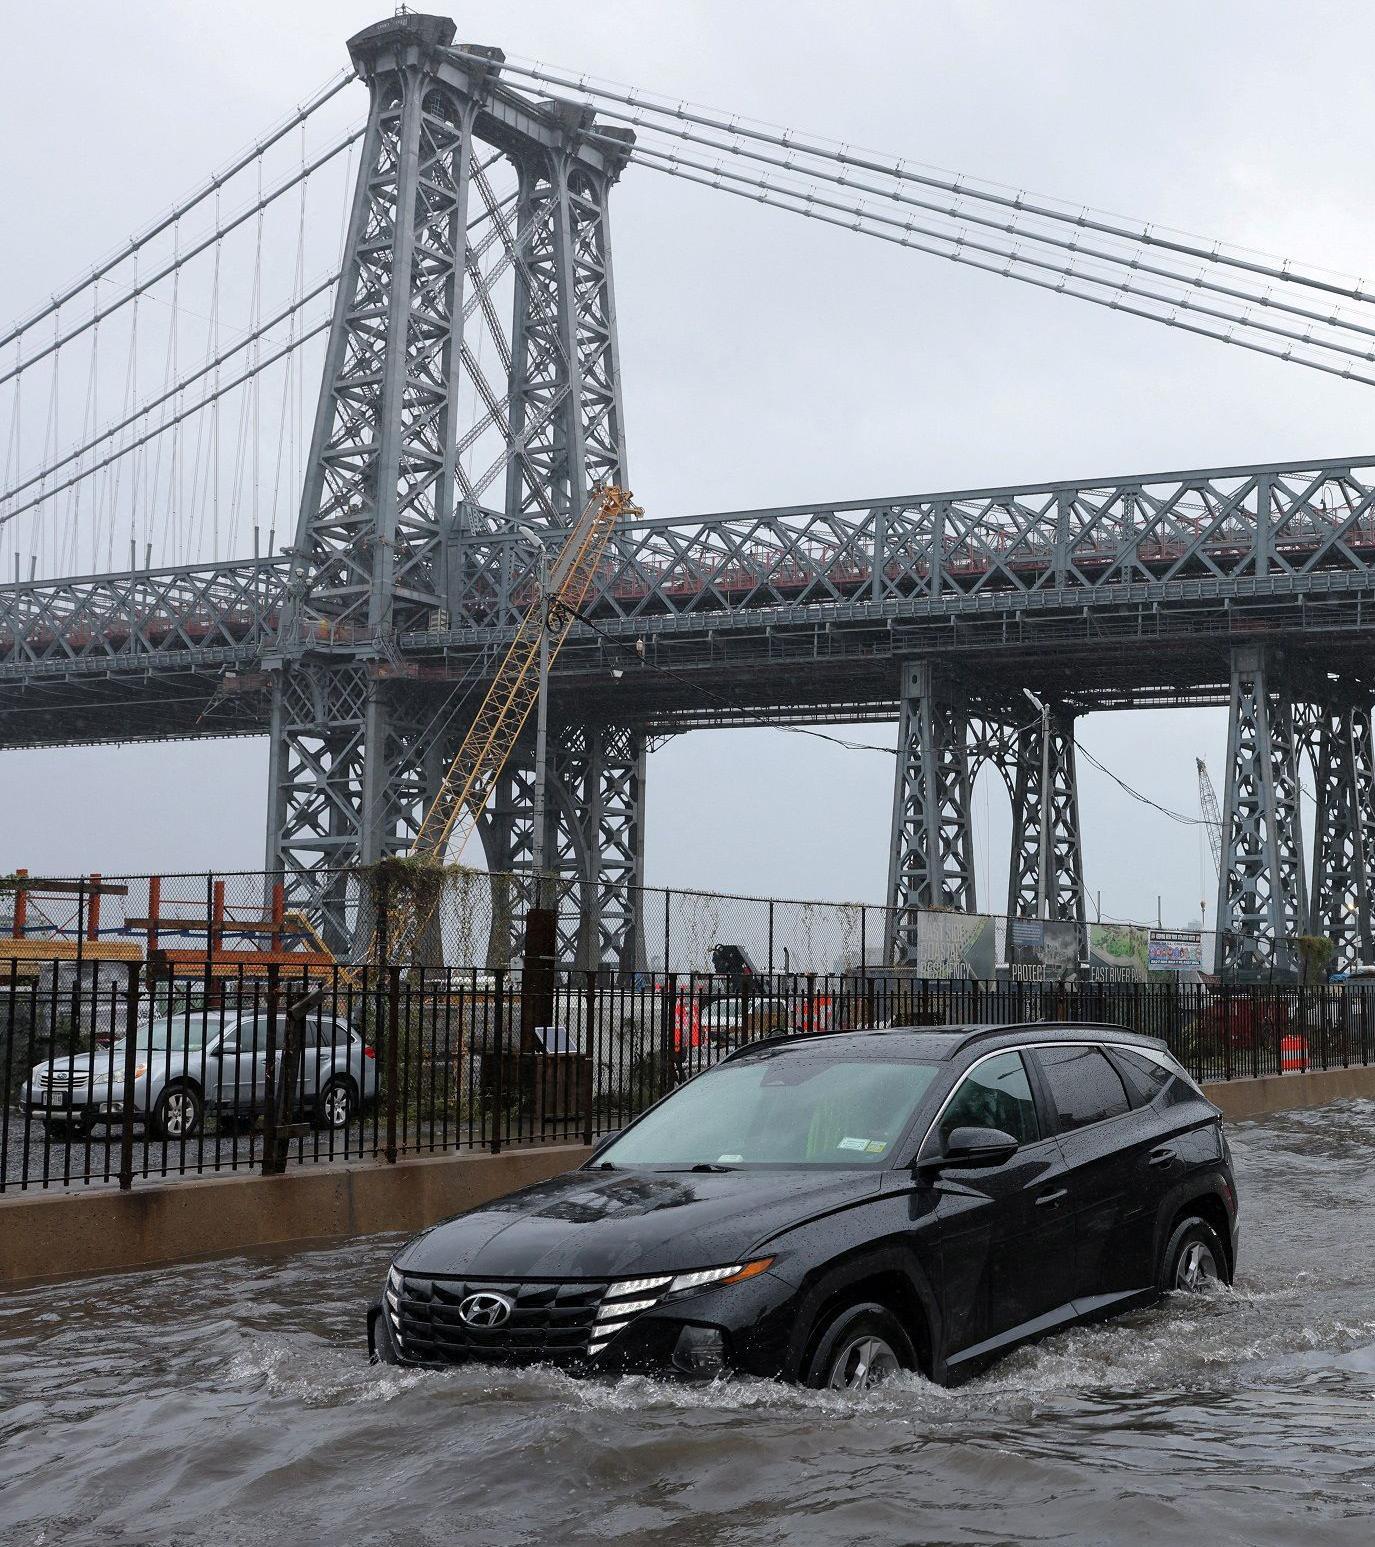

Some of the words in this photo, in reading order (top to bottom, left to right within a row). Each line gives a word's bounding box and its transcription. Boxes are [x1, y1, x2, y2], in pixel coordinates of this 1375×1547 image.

[1012, 963, 1046, 982] PROTECT
[1091, 966, 1109, 983] EAST
[1109, 967, 1131, 983] RIVER
